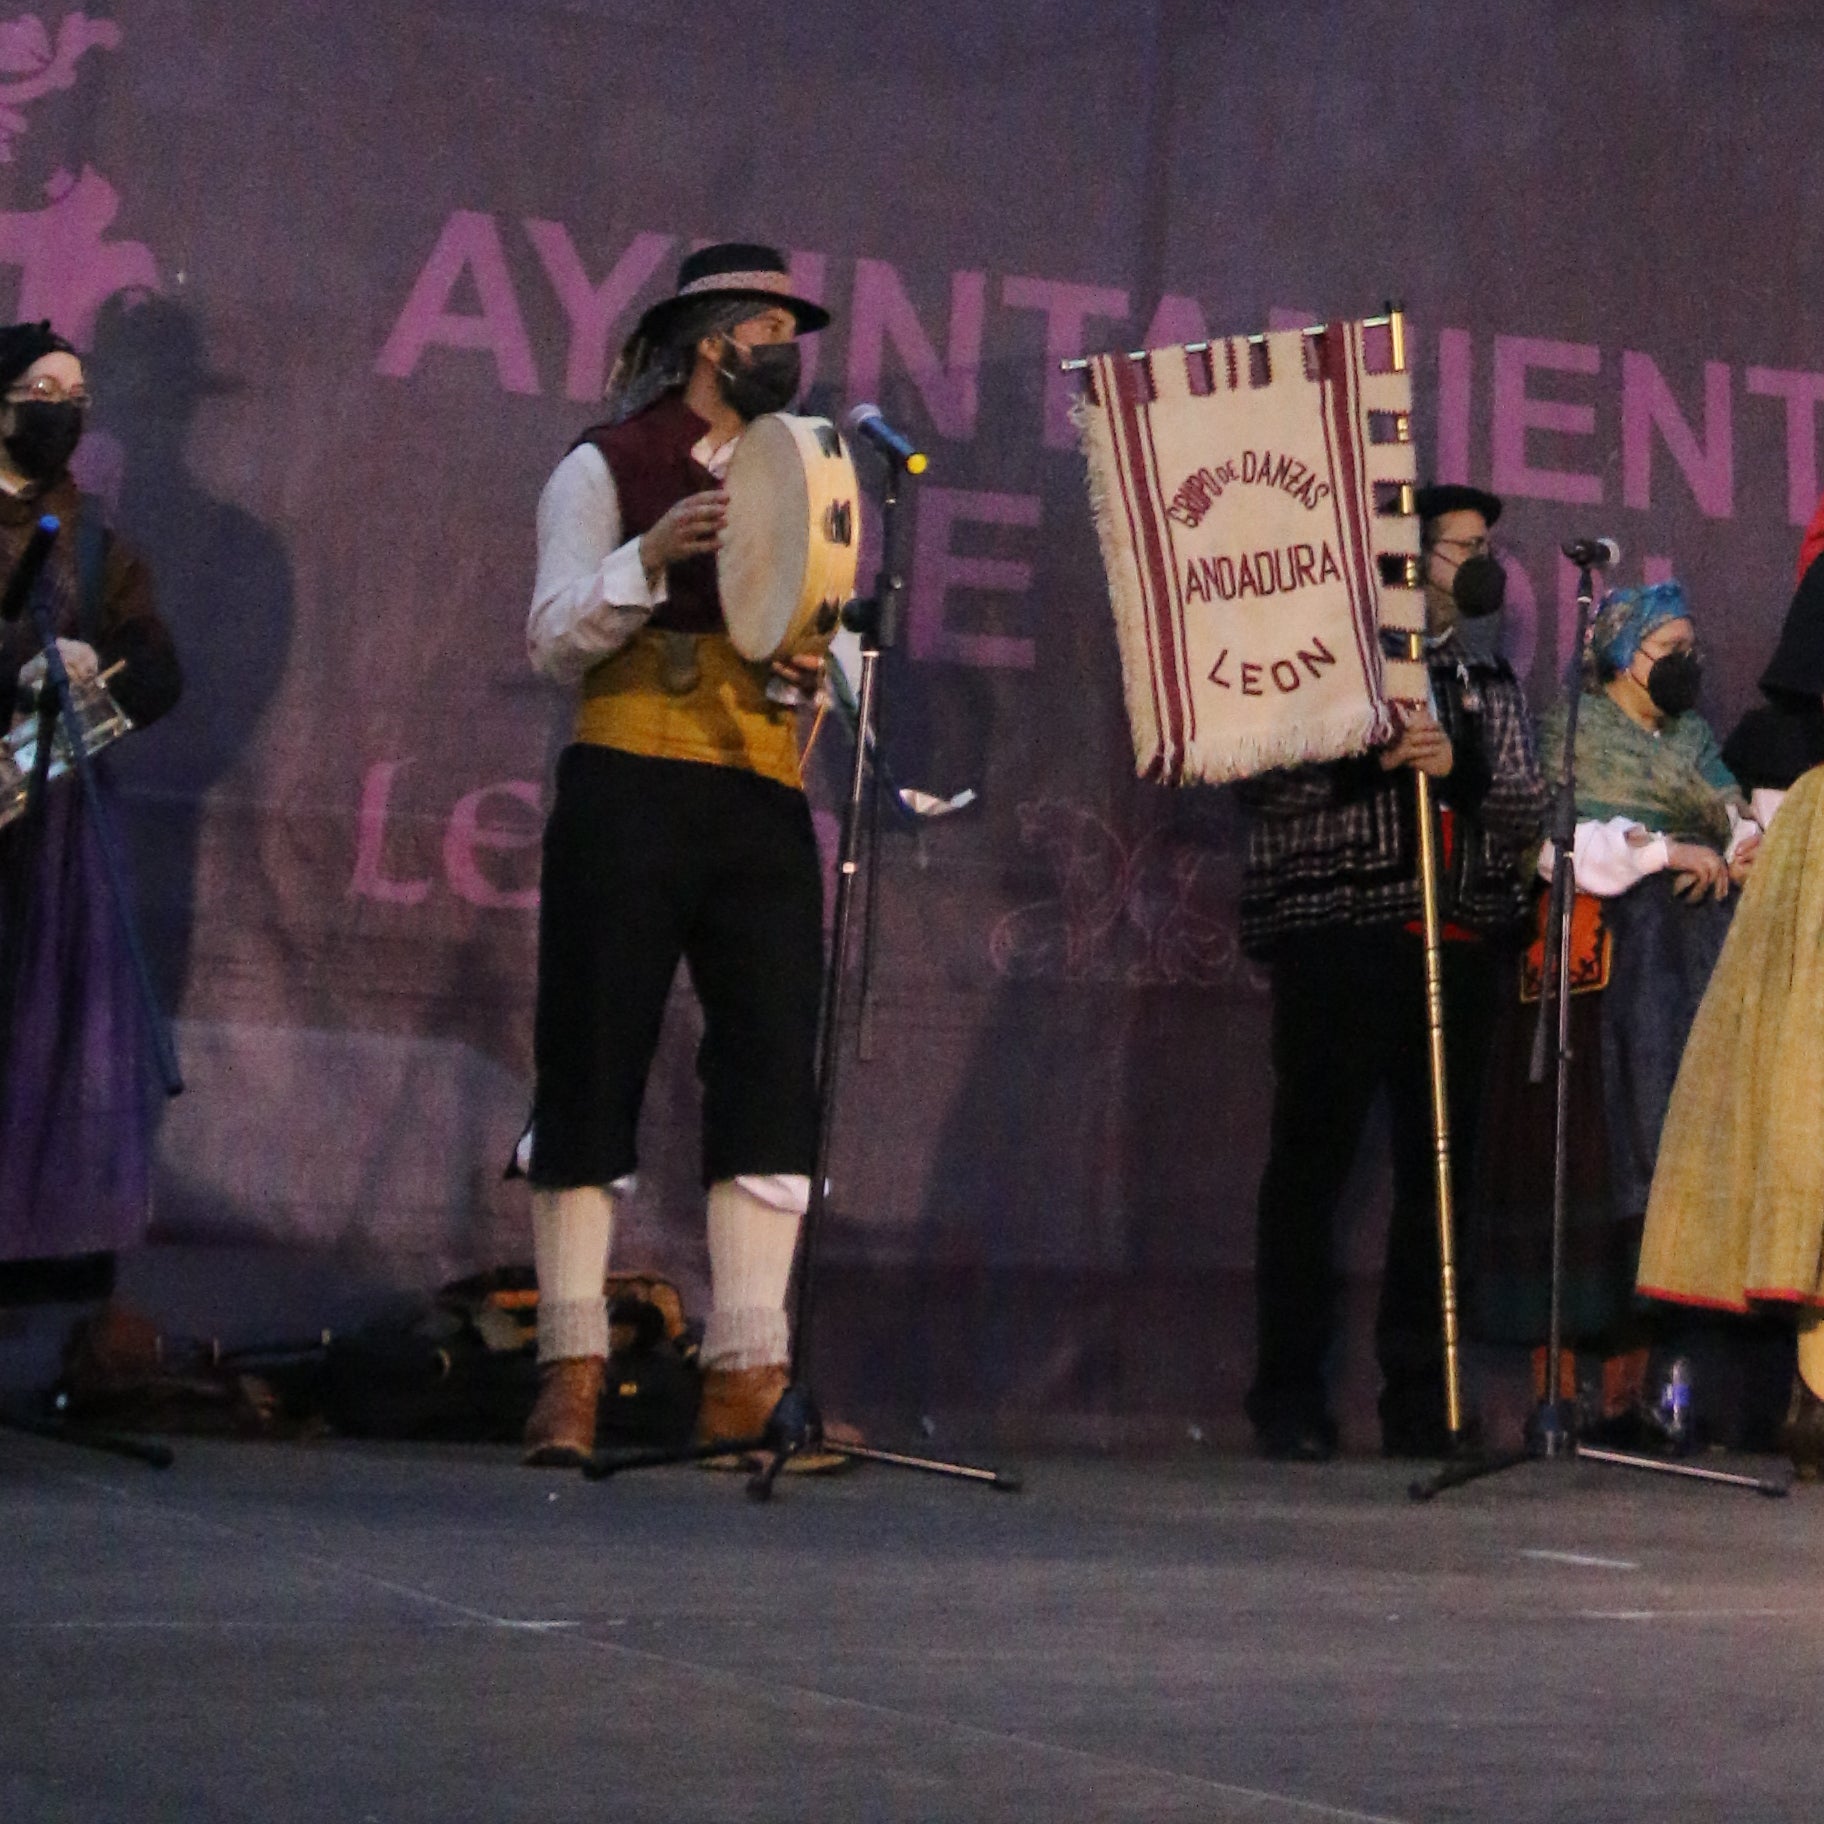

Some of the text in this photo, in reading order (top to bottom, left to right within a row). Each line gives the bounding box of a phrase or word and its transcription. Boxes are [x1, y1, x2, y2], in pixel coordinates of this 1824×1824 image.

[1166, 450, 1330, 528] GRUPO DE DANZAS
[1185, 540, 1341, 603] ANDADURA
[1208, 637, 1336, 696] LEON
